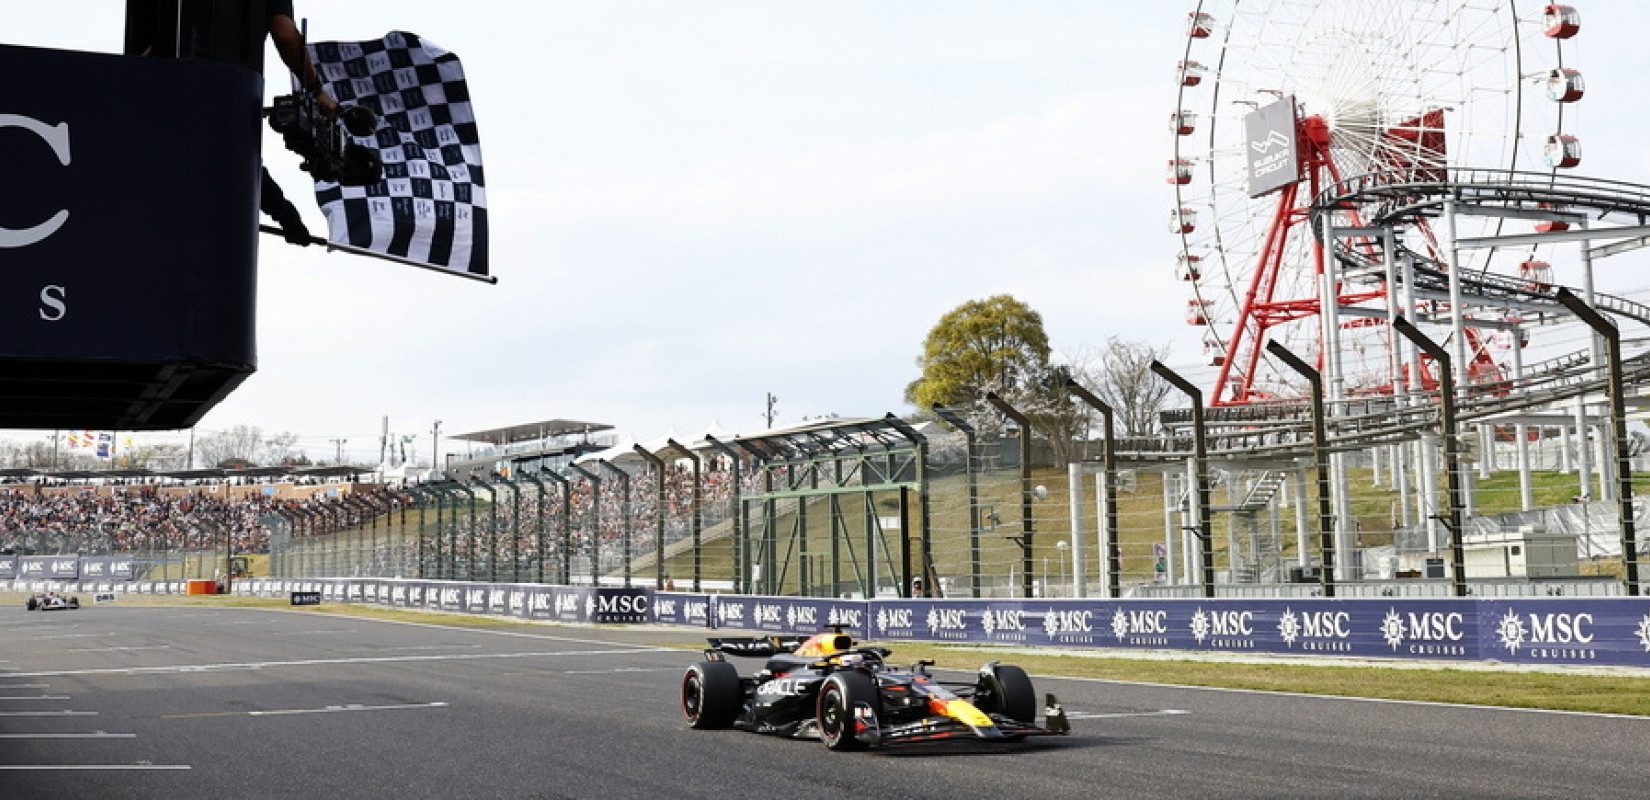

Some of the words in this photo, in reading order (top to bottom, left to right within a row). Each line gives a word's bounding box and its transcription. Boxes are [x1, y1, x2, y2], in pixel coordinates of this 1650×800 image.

[39, 285, 66, 321] S
[598, 595, 648, 613] MSC
[726, 602, 744, 618] MSC
[762, 604, 782, 622] MSC
[797, 606, 817, 624] MSC
[840, 608, 862, 628] MSC
[888, 608, 913, 628] MSC
[939, 609, 966, 630] MSC
[996, 610, 1026, 631] MSC
[1060, 610, 1093, 632] MSC
[1130, 610, 1167, 634] MSC
[1211, 611, 1253, 636] MSC
[1302, 611, 1350, 638] MSC
[1408, 612, 1464, 640] MSC
[1530, 613, 1594, 643] MSC
[1302, 642, 1352, 651] CRUISES
[1409, 645, 1466, 656] CRUISES
[1531, 649, 1596, 660] CRUISES
[756, 679, 806, 696] ORACLE
